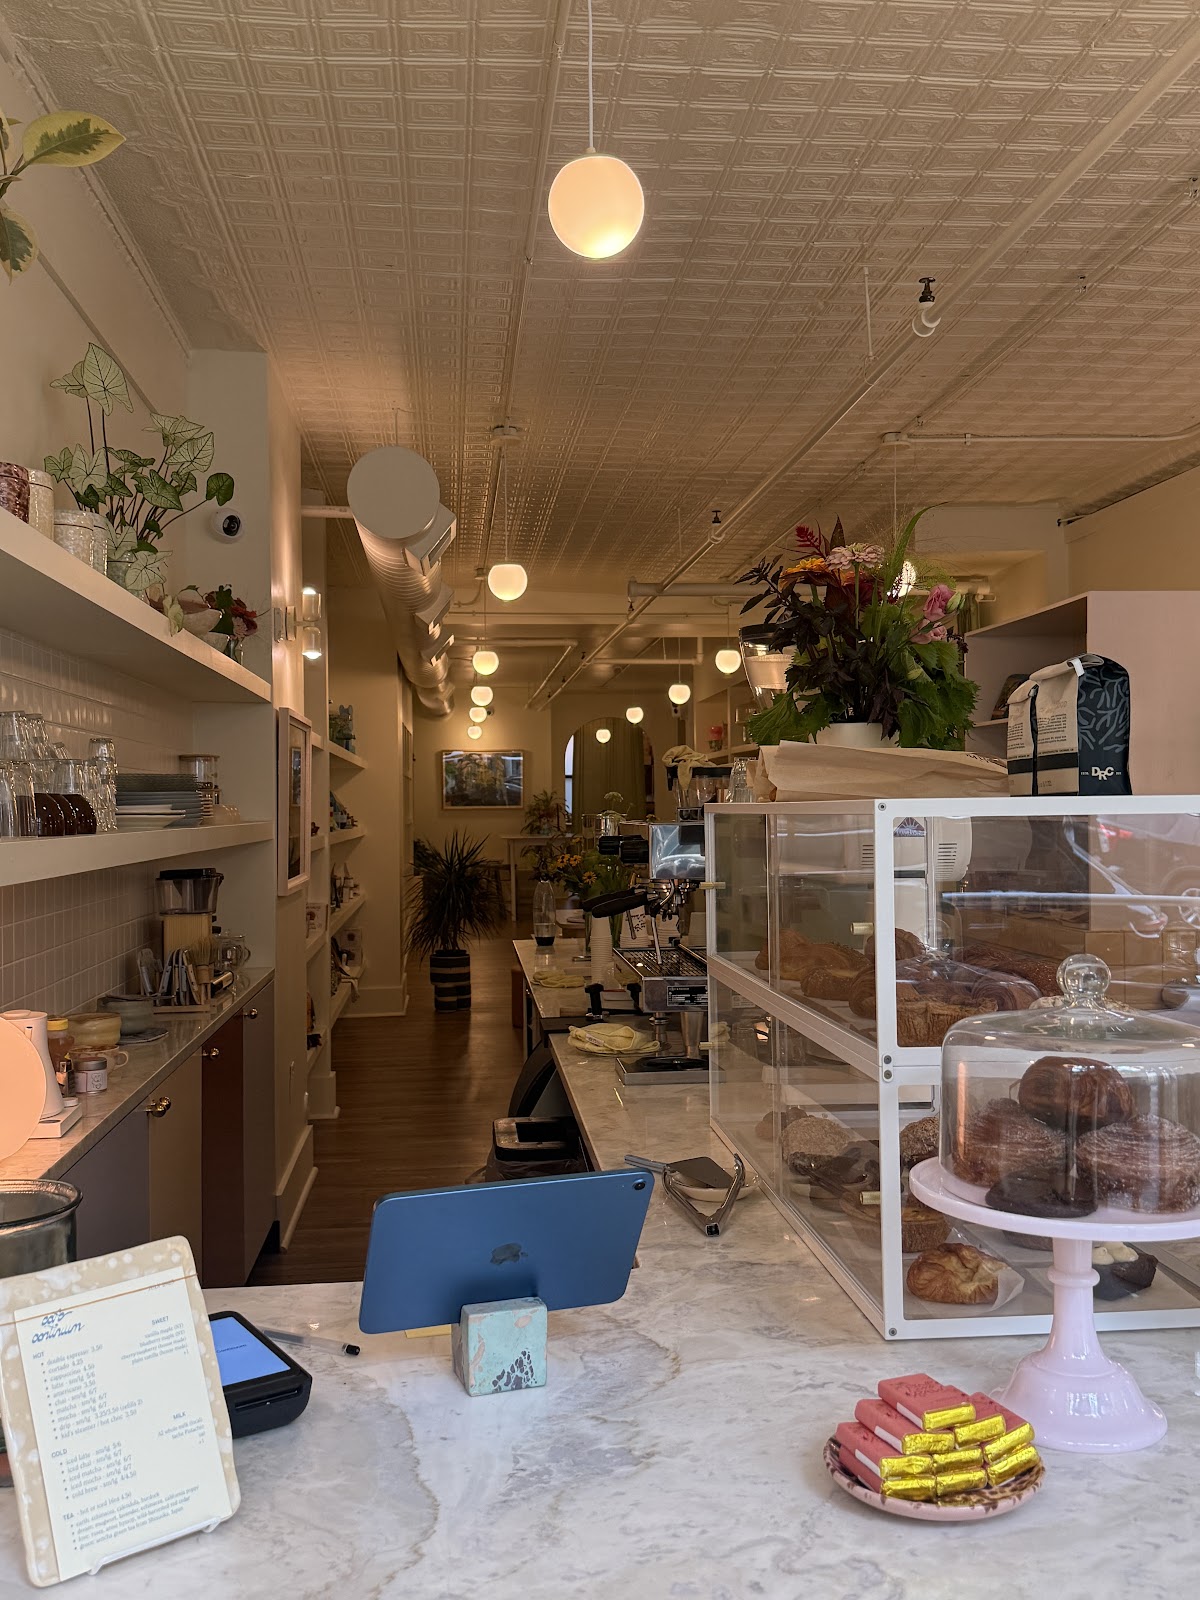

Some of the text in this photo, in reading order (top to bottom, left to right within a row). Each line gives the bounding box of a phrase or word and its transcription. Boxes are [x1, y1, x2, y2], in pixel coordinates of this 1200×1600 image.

[1091, 766, 1114, 780] DRC
[152, 1316, 168, 1325] SWEET
[48, 1358, 83, 1374] cortado 4.25
[50, 1364, 95, 1382] cappuccino 4.50
[53, 1379, 96, 1398] americano 3.50
[55, 1398, 67, 1406] chai
[56, 1404, 77, 1415] matcha
[125, 1409, 137, 1418] 3.50
[58, 1413, 77, 1423] mocha
[173, 1411, 186, 1420] MILK
[59, 1422, 71, 1431] drip
[51, 1449, 67, 1458] COLD
[80, 1460, 92, 1469] chai
[82, 1466, 102, 1478] matcha
[83, 1475, 102, 1486] mocha
